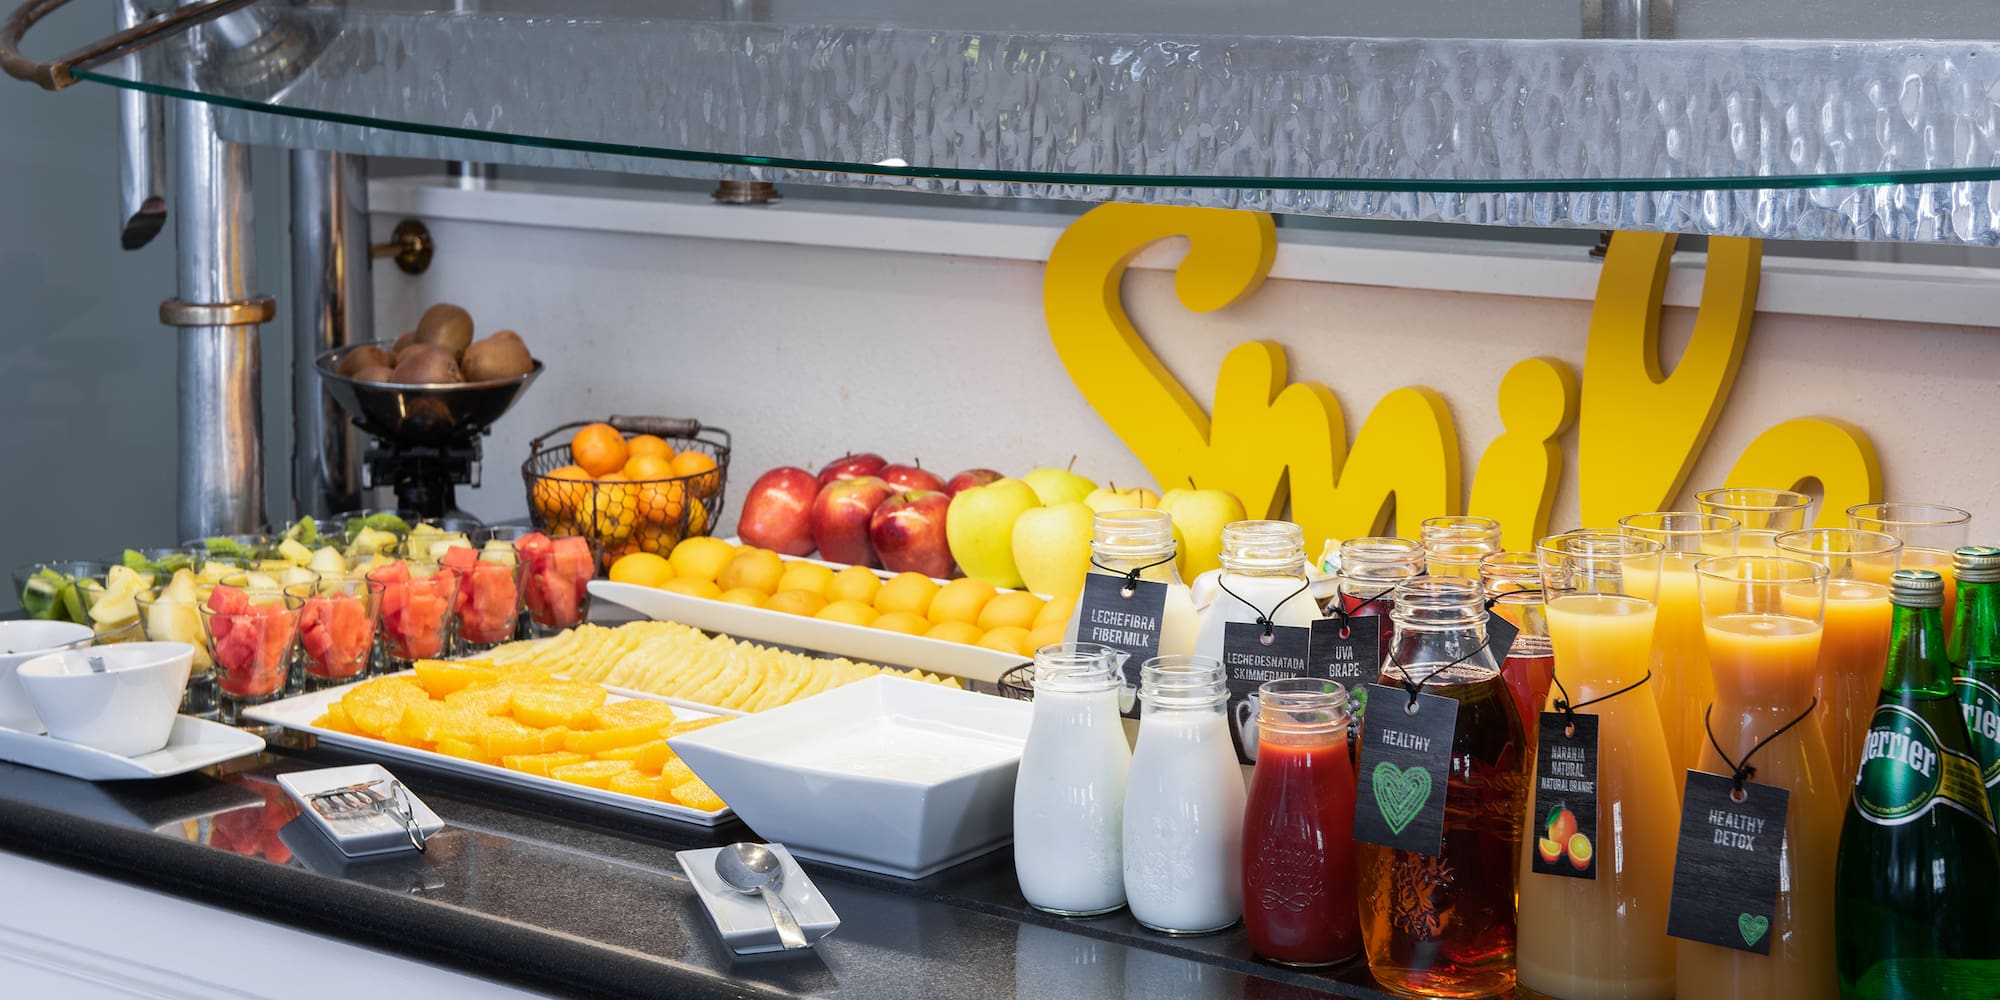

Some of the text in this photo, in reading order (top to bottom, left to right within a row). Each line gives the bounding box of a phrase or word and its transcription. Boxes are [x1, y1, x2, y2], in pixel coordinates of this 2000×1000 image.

[1091, 609, 1156, 631] LECHE FIBRA
[1092, 626, 1150, 648] FIBER MILK
[1227, 652, 1305, 670] LECHE DESNATADA
[1335, 645, 1354, 660] UVA
[1233, 667, 1275, 681] SKIMMED
[1329, 662, 1360, 677] GRAPE
[1382, 728, 1431, 752] HEALTHY
[1551, 745, 1585, 762] NARANJA
[1551, 761, 1584, 777] NATURAL
[1541, 777, 1594, 794] NATURAL ORANGE
[1708, 808, 1766, 833] HEALTHY
[1713, 828, 1756, 852] DETOX
